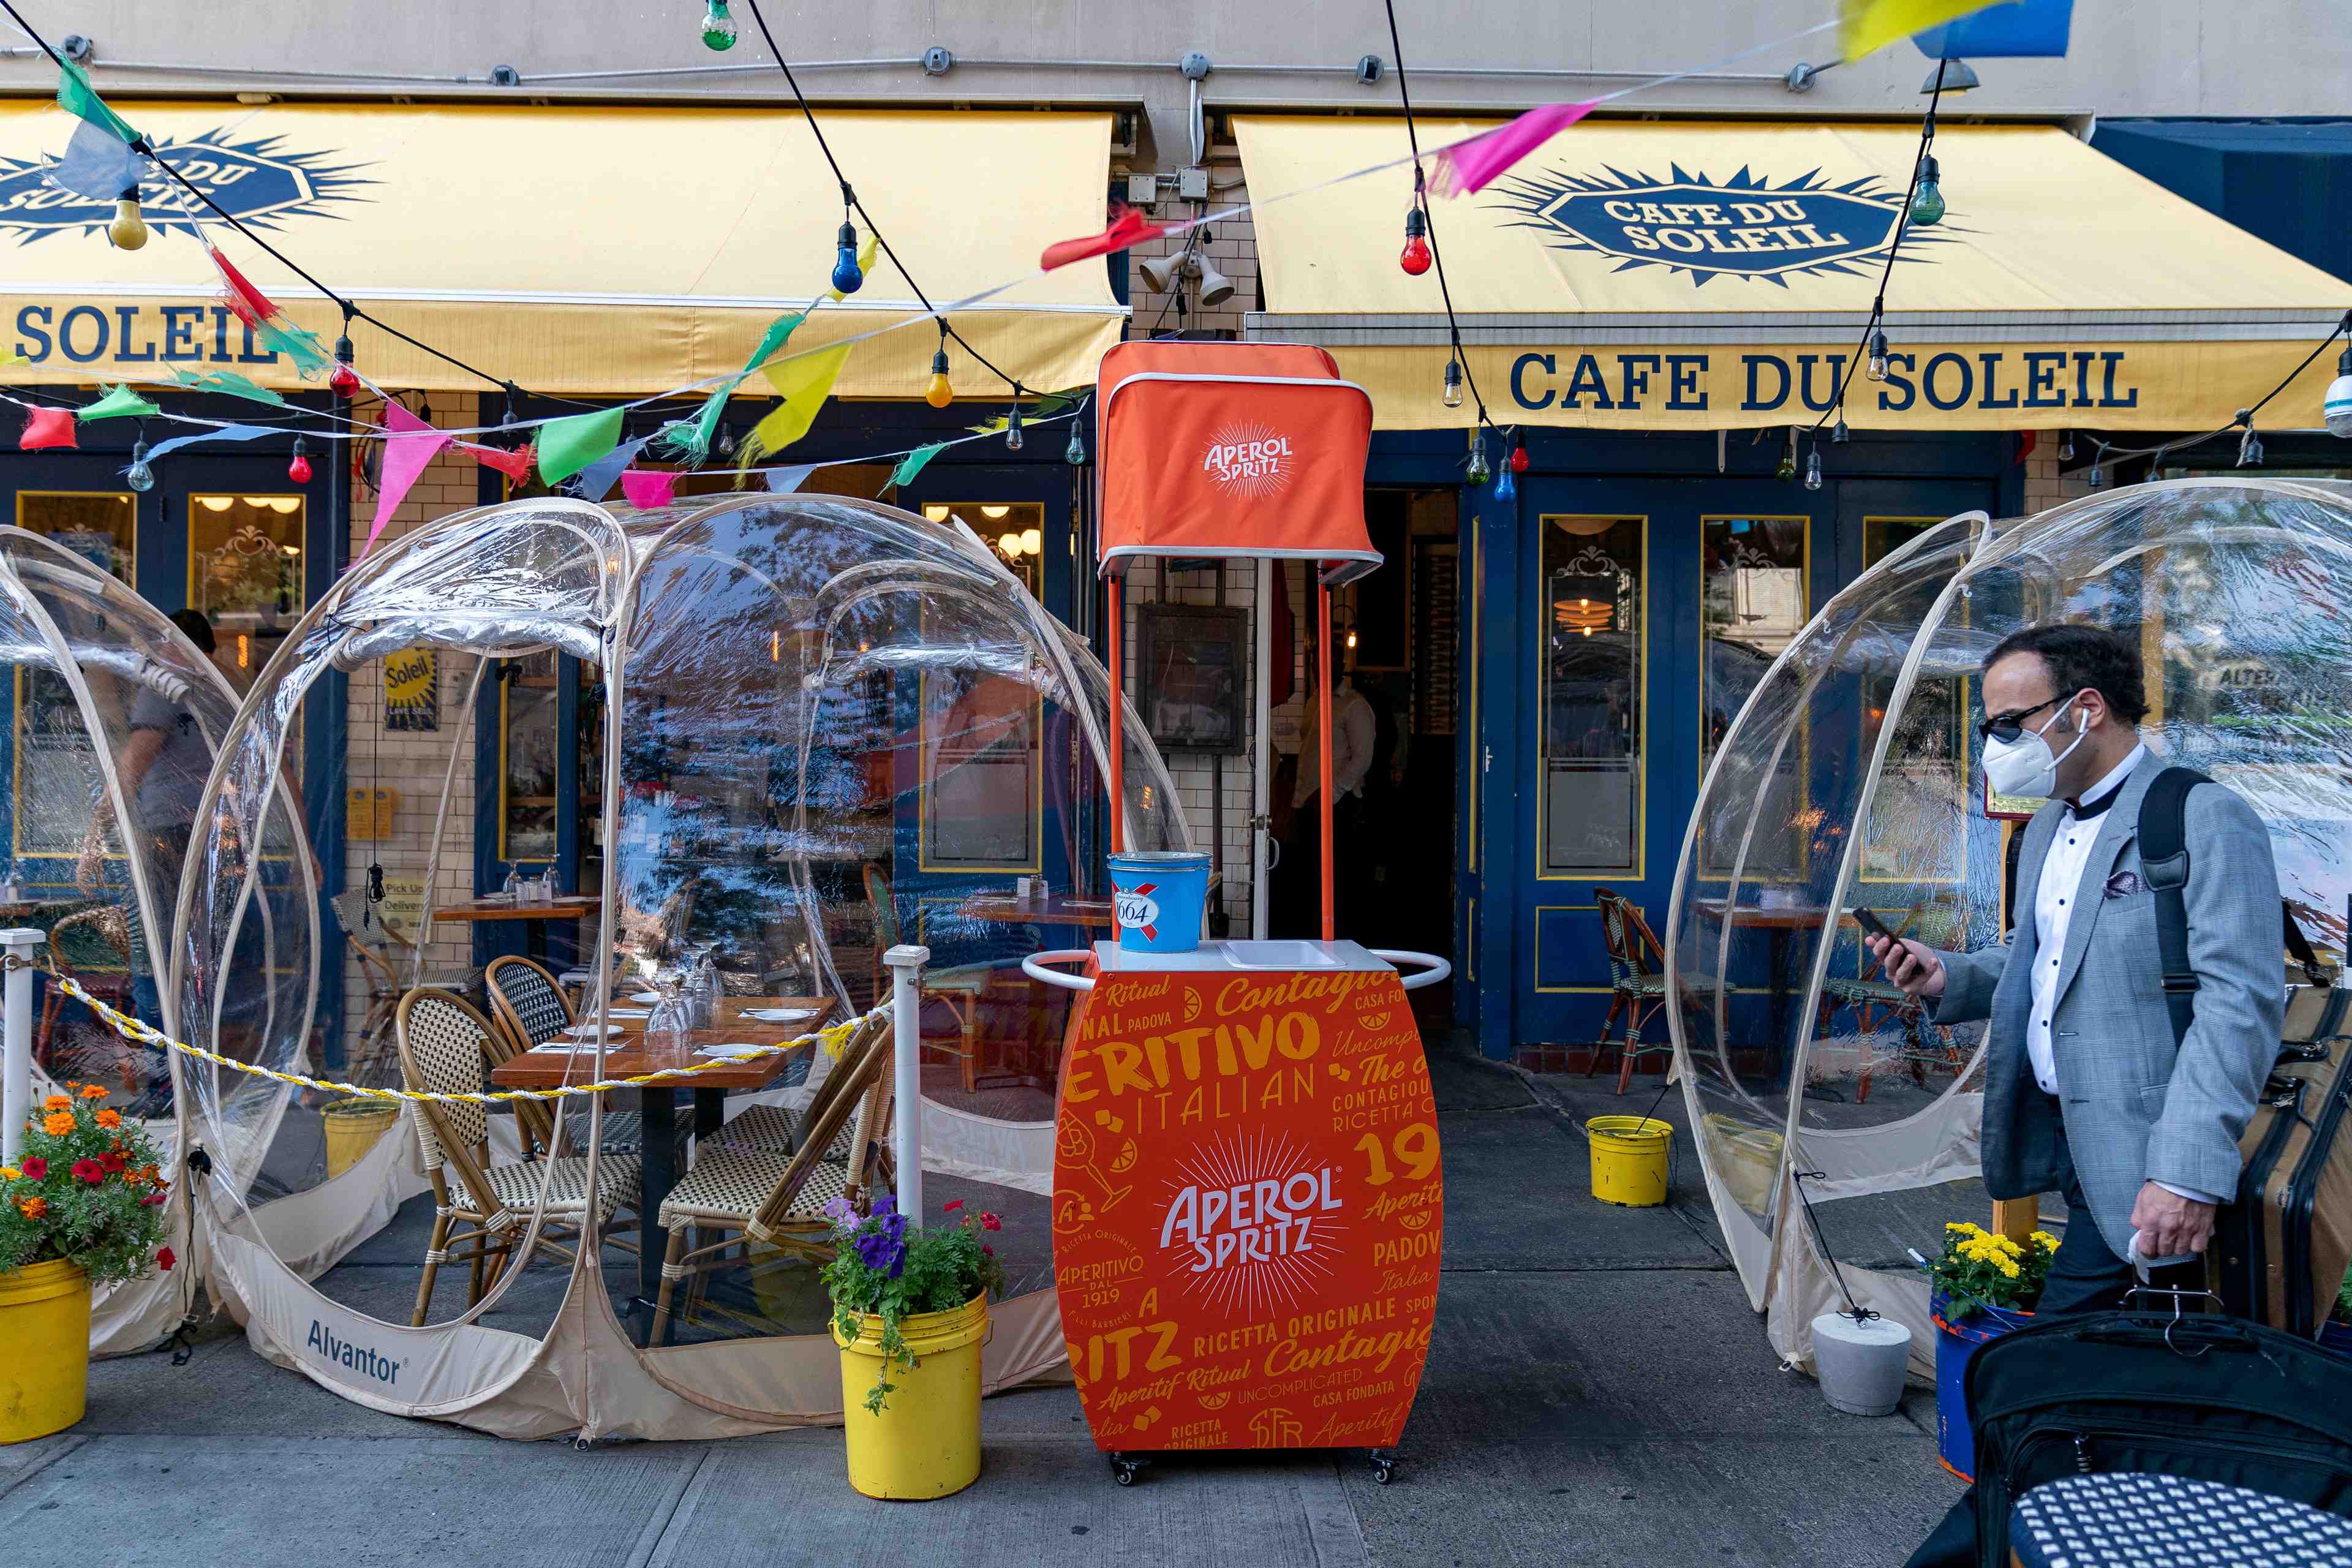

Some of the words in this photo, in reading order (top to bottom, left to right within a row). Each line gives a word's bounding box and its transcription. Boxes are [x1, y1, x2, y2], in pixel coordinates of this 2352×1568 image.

[1604, 199, 1733, 225] CAFE
[1730, 199, 1808, 222] DU
[1622, 224, 1850, 254] SOLEIL
[15, 305, 278, 364] SOLEIL
[1510, 353, 1709, 411] CAFE
[1741, 353, 1845, 411] DU
[1878, 352, 2138, 411] SOLEIL
[1204, 437, 1293, 470] APEROL
[386, 655, 429, 688] Soleil
[386, 884, 407, 893] Pick
[410, 884, 424, 894] Up
[385, 901, 423, 910] Deliver
[1107, 974, 1171, 1008] Ritual
[1355, 993, 1384, 1010] CASA
[1128, 1012, 1172, 1033] PADOVA
[1359, 1054, 1406, 1085] The
[1138, 1063, 1314, 1134] ITALIAN
[1333, 1077, 1429, 1112] CONTAGIOU
[1333, 1101, 1413, 1133] RICETTA
[1354, 1123, 1440, 1186] 19
[1160, 1167, 1343, 1248] APEROL
[1058, 1255, 1144, 1286] APERITIVO
[1090, 1281, 1112, 1291] DAL
[1373, 1265, 1435, 1294] Italia
[1082, 1288, 1120, 1308] 1919
[1194, 1322, 1278, 1358] RICETTA
[1289, 1297, 1396, 1338] ORIGINALE
[307, 1319, 400, 1384] Alvantor
[1098, 1372, 1185, 1413] Aperitif
[1186, 1359, 1251, 1392] Ritual
[1237, 1368, 1362, 1404] UNCOMPLICATED
[1313, 1391, 1343, 1408] CASA
[1347, 1381, 1395, 1401] FONDATA
[1172, 1419, 1221, 1439] RICETTA
[1309, 1401, 1403, 1447] Aperitif
